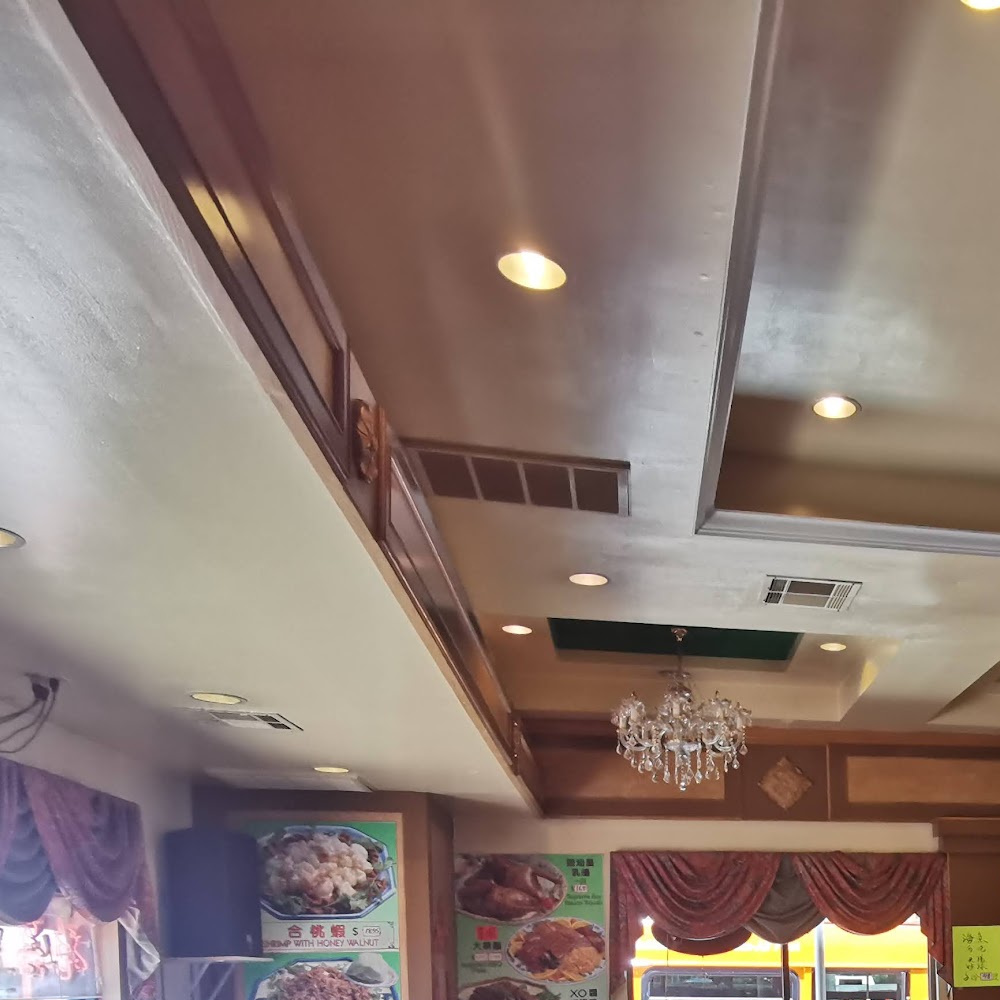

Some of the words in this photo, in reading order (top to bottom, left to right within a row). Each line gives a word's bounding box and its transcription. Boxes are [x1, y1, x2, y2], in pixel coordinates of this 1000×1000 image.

[287, 924, 346, 938] 合桃蝦
[347, 939, 379, 947] WALNUT
